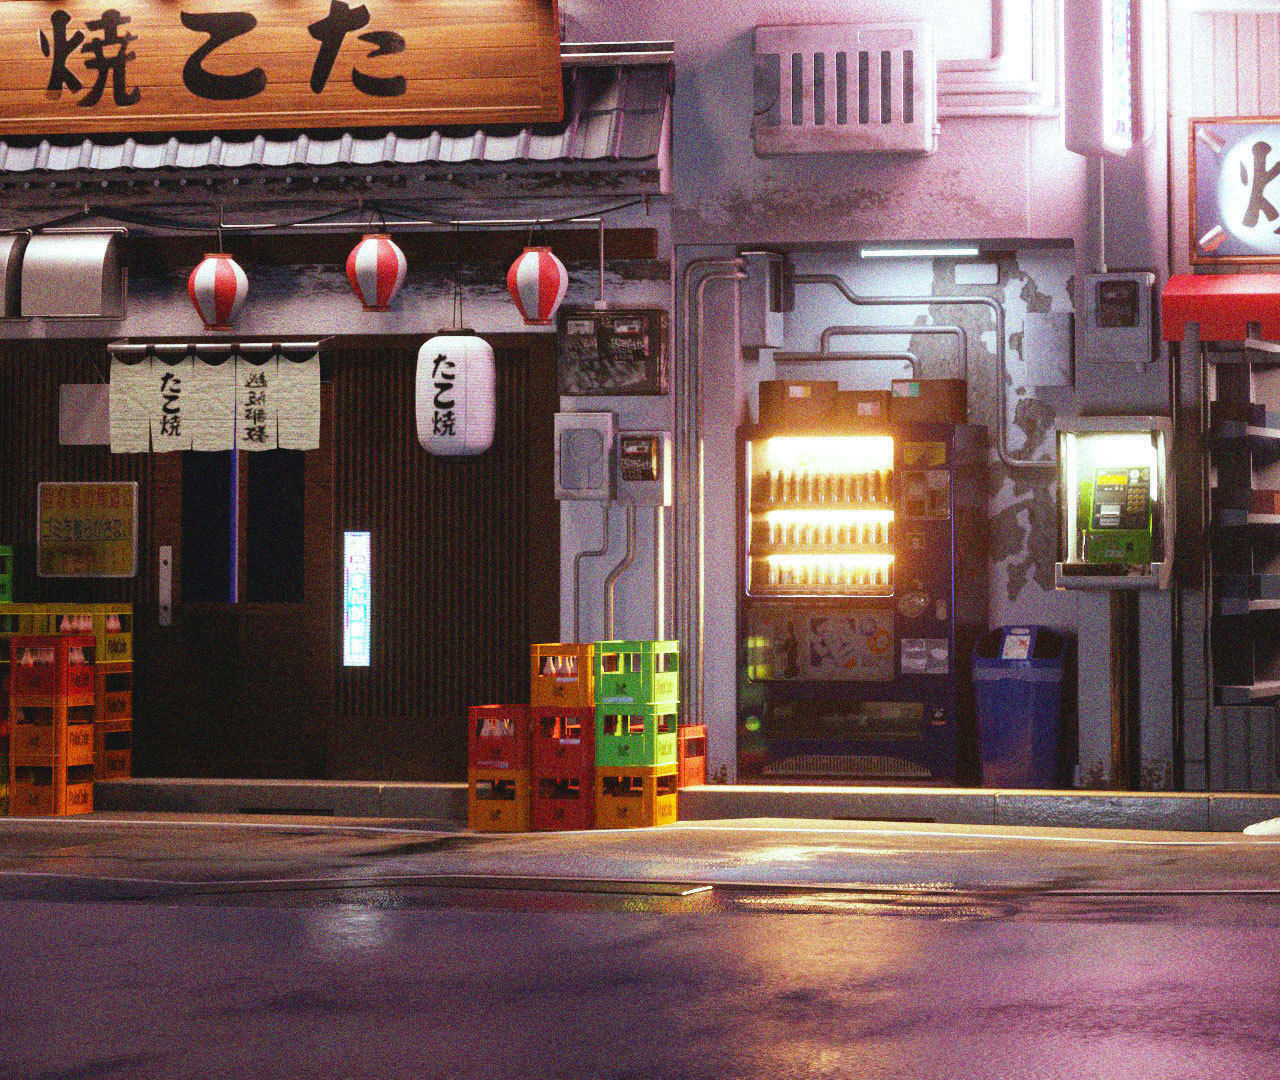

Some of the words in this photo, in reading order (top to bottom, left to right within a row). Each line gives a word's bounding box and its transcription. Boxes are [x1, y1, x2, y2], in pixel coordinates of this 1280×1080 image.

[160, 372, 182, 437] たこ焼
[431, 353, 456, 436] たこ焼
